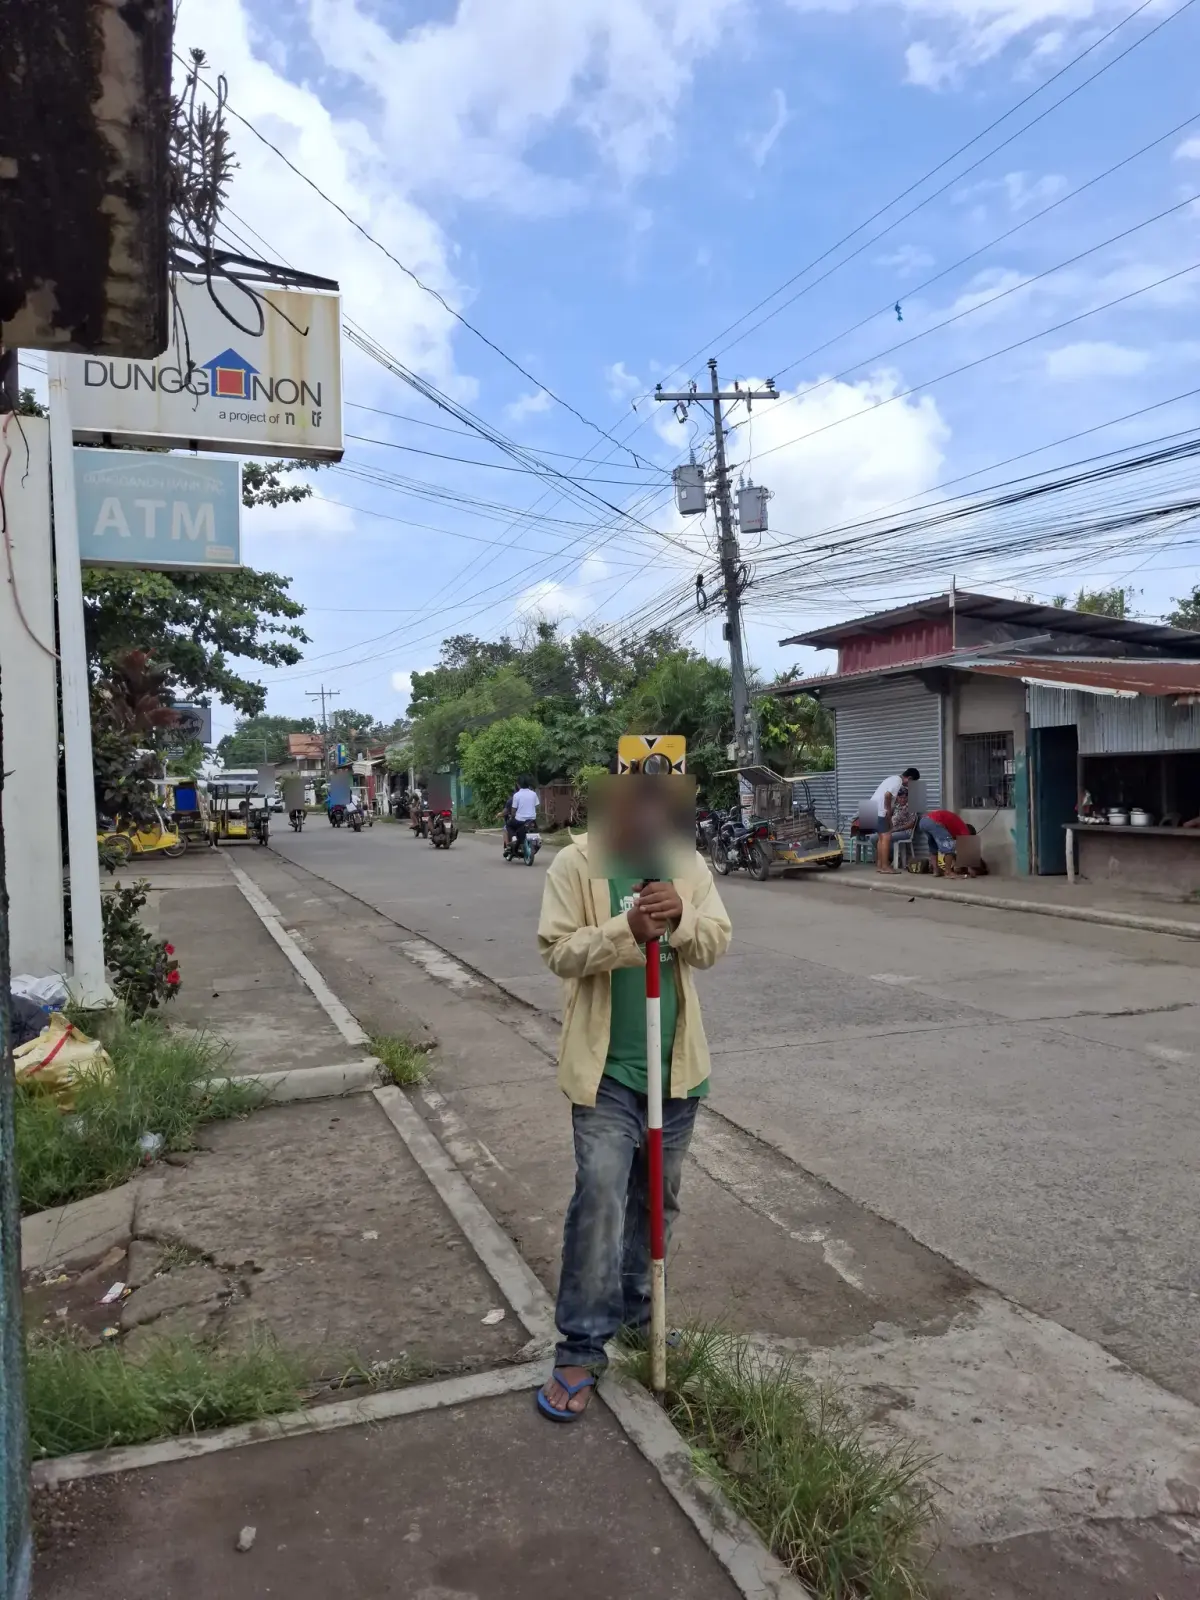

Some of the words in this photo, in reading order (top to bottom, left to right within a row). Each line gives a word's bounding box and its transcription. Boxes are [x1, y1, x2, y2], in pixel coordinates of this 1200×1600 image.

[218, 411, 227, 419] a
[229, 411, 267, 423] project
[268, 413, 281, 424] of
[92, 497, 216, 542] ATM
